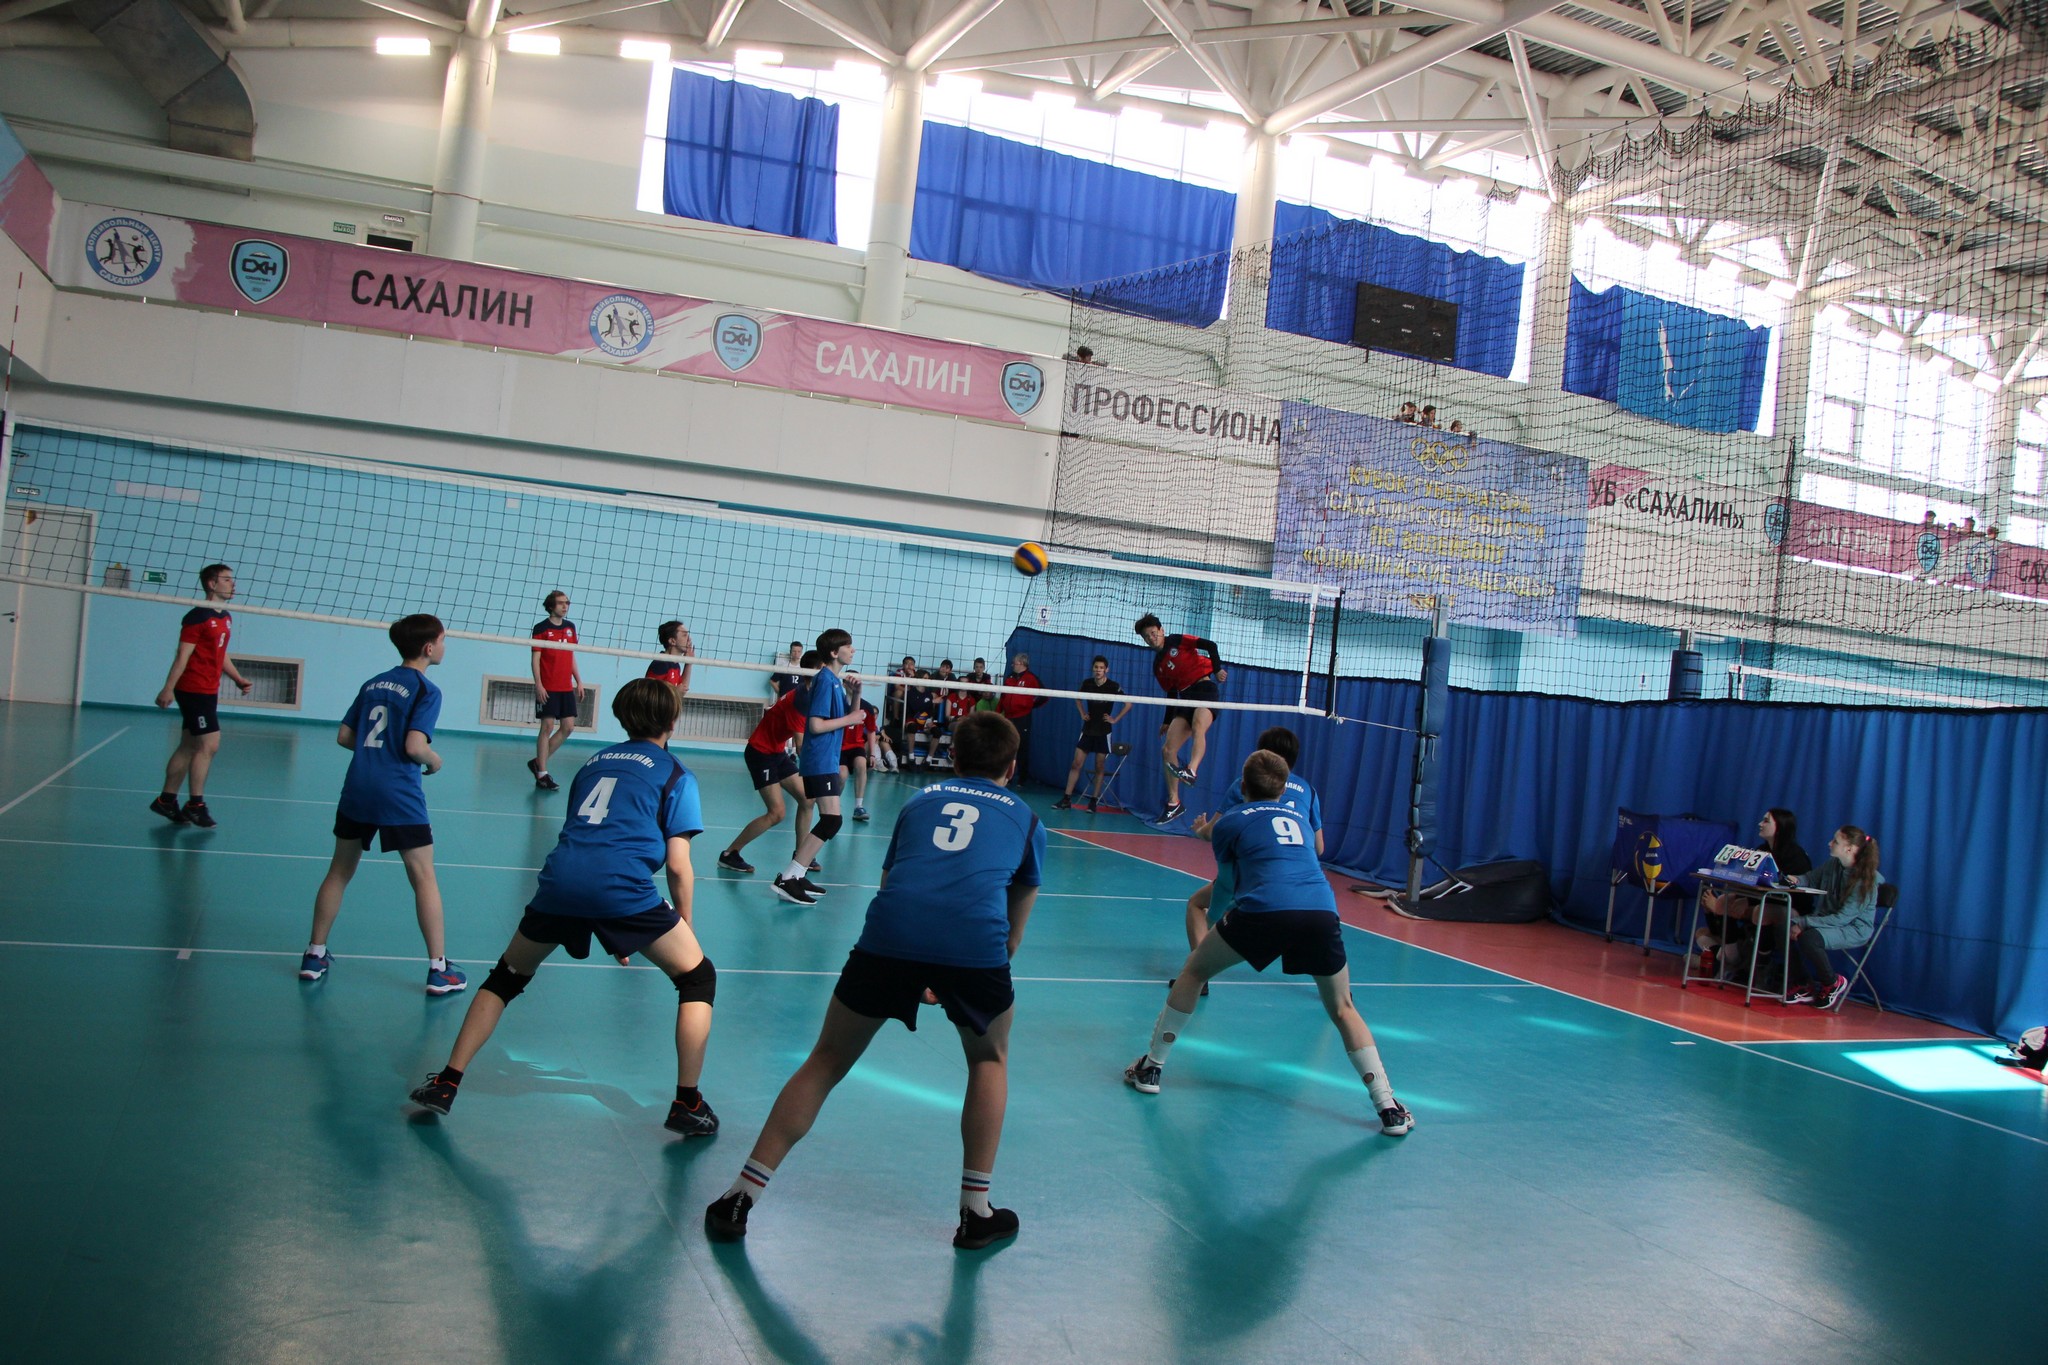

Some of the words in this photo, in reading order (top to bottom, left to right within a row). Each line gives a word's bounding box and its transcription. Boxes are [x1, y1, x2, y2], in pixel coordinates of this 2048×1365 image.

[87, 219, 149, 251] ВОЛЕЙБОЛЬНЫЙ
[148, 234, 161, 263] ЦЕНТР
[99, 269, 144, 285] САХАЛИН
[351, 270, 533, 328] САХАЛИН
[590, 295, 644, 327] ВОЛЕЙБОЛЬНЫЙ
[600, 342, 639, 357] САХАЛИН
[815, 341, 972, 396] САХАЛИН
[1350, 465, 1408, 494] КУБОК
[1623, 487, 1744, 529] «САХАЛИН»
[1370, 525, 1395, 548] ПО
[791, 675, 800, 684] 12
[363, 705, 389, 749] 2
[601, 752, 655, 769] «САХАЛИН»
[763, 769, 770, 781] 7
[577, 776, 618, 825] 4
[826, 781, 832, 791] 1
[923, 784, 942, 794] ВЦ
[944, 786, 1016, 807] «САХАЛИН»
[932, 802, 980, 851] 3
[1271, 816, 1304, 845] 9
[1717, 846, 1734, 861] 13
[1747, 854, 1762, 867] 3
